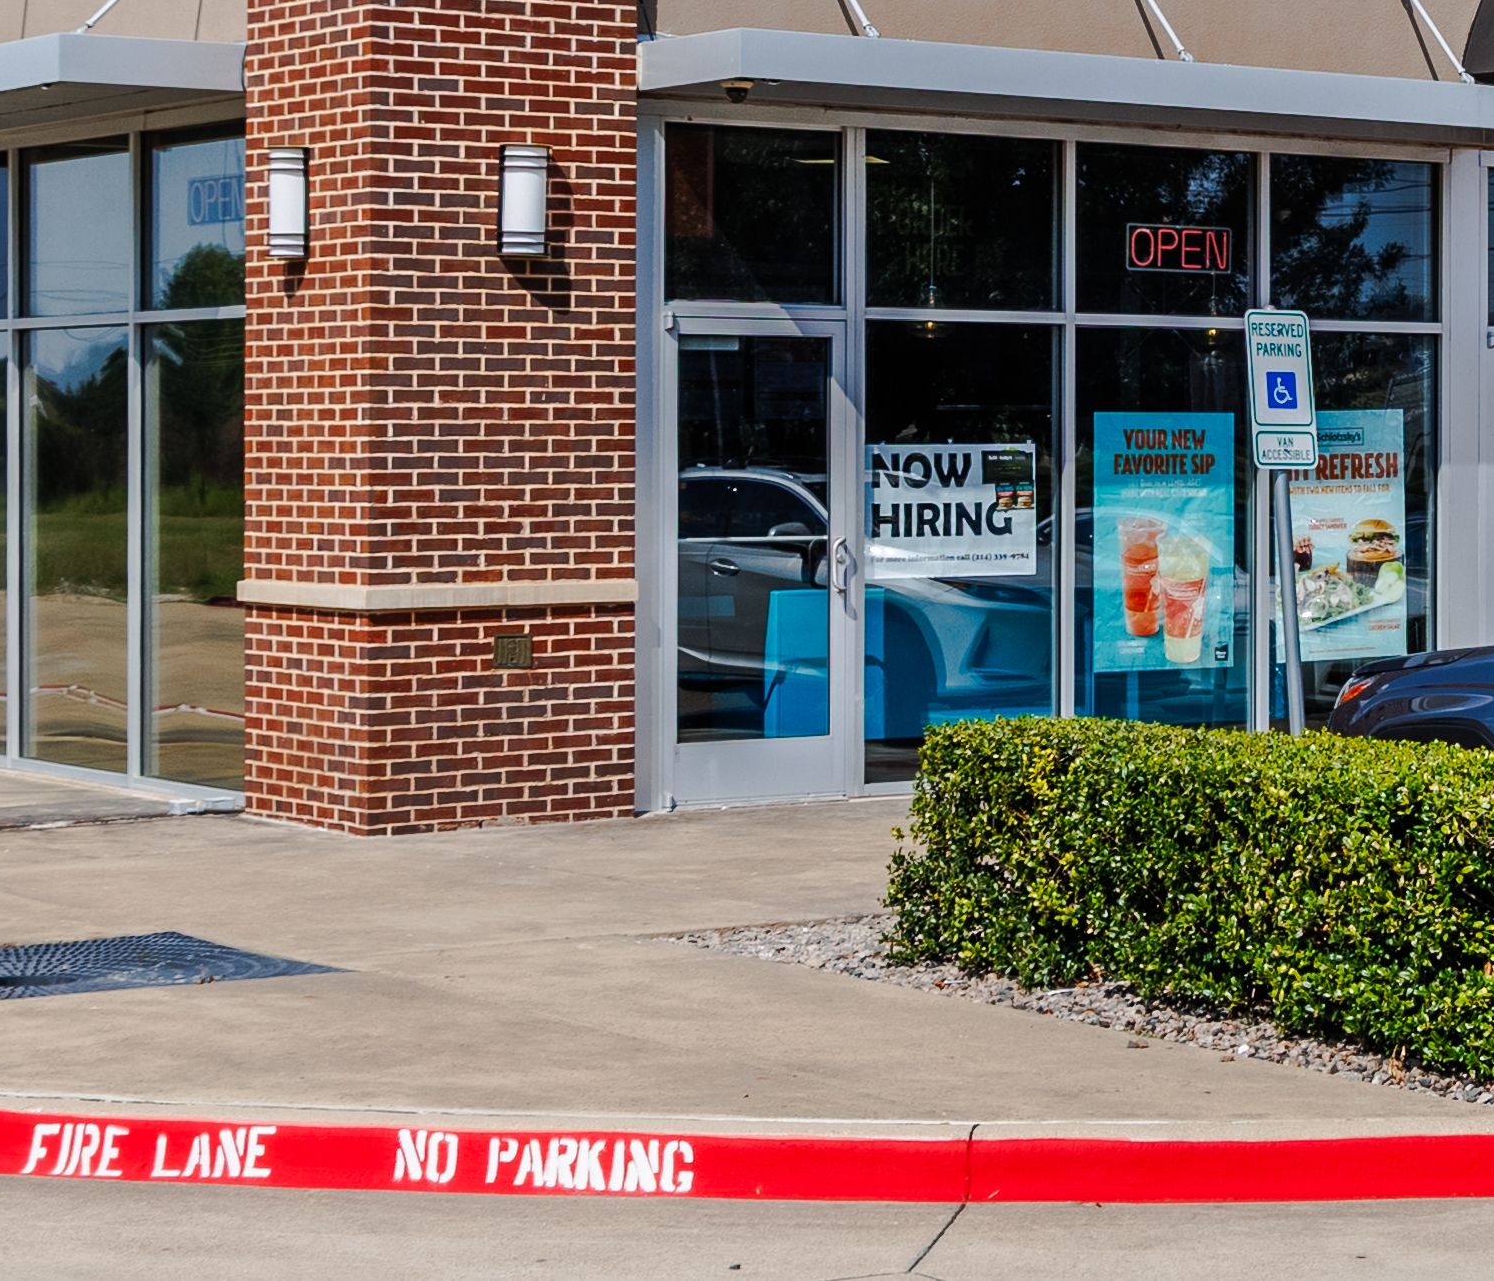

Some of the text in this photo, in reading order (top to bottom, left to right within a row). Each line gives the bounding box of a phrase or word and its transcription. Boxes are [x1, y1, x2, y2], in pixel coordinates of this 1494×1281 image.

[191, 179, 244, 223] OPEN
[1131, 227, 1227, 269] OPEN
[1251, 322, 1304, 338] RESERVED
[1256, 343, 1302, 357] PARKING
[1123, 429, 1206, 450] YOUR NEW
[1277, 437, 1294, 448] VAN
[1113, 453, 1215, 475] FAVORITE SIP
[1262, 449, 1312, 461] ACCESSIBLE
[1315, 452, 1399, 480] REFRESH
[871, 452, 973, 489] NOW
[871, 502, 1013, 538] HIRING
[20, 1123, 695, 1195] FIRE LANE NO PARKING
